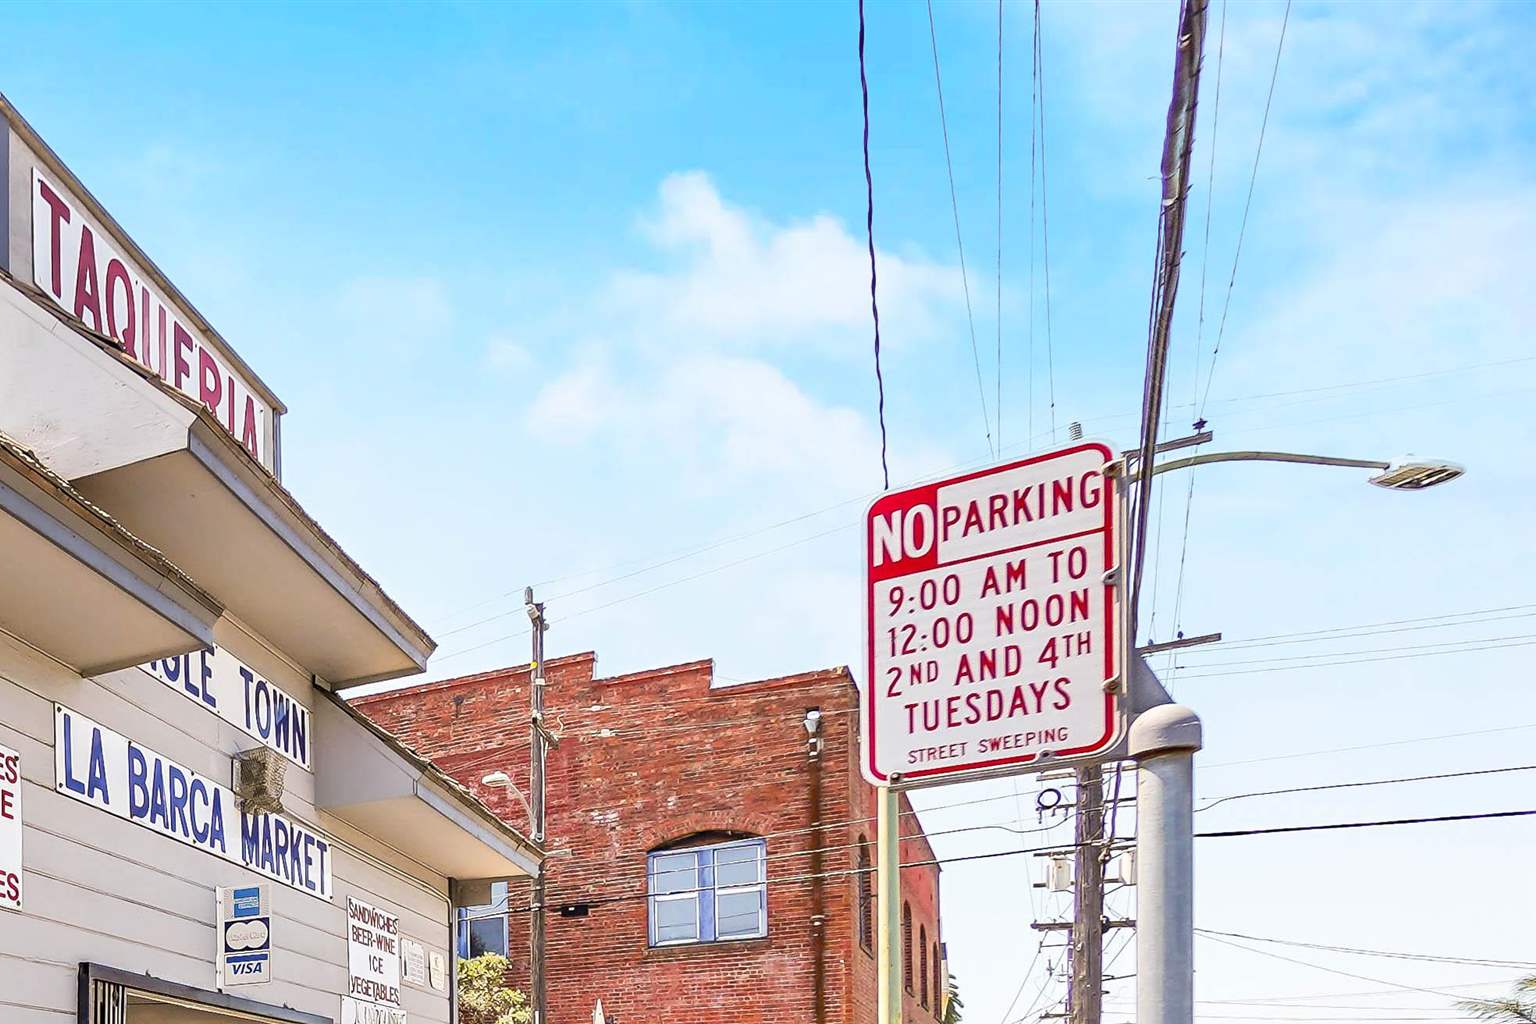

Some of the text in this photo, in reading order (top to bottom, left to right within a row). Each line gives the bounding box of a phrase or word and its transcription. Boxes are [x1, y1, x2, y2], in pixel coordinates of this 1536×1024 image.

[872, 470, 1102, 568] NO PARKING
[888, 545, 1088, 617] 9:00 AM TO
[887, 588, 1090, 657] 12:00 NOON
[886, 630, 1092, 698] 2ND AND 4TH
[239, 665, 307, 765] TOWN
[904, 676, 1072, 734] TUESDAYS
[907, 726, 1069, 764] STREET SWEEPING
[64, 713, 328, 895] LA BARCA MARKET
[348, 901, 398, 936] SANDWICHES
[351, 925, 396, 956] BEER-WINE
[232, 962, 263, 975] VISA
[350, 974, 401, 1006] VEGETABLES
[368, 954, 384, 974] ICE
